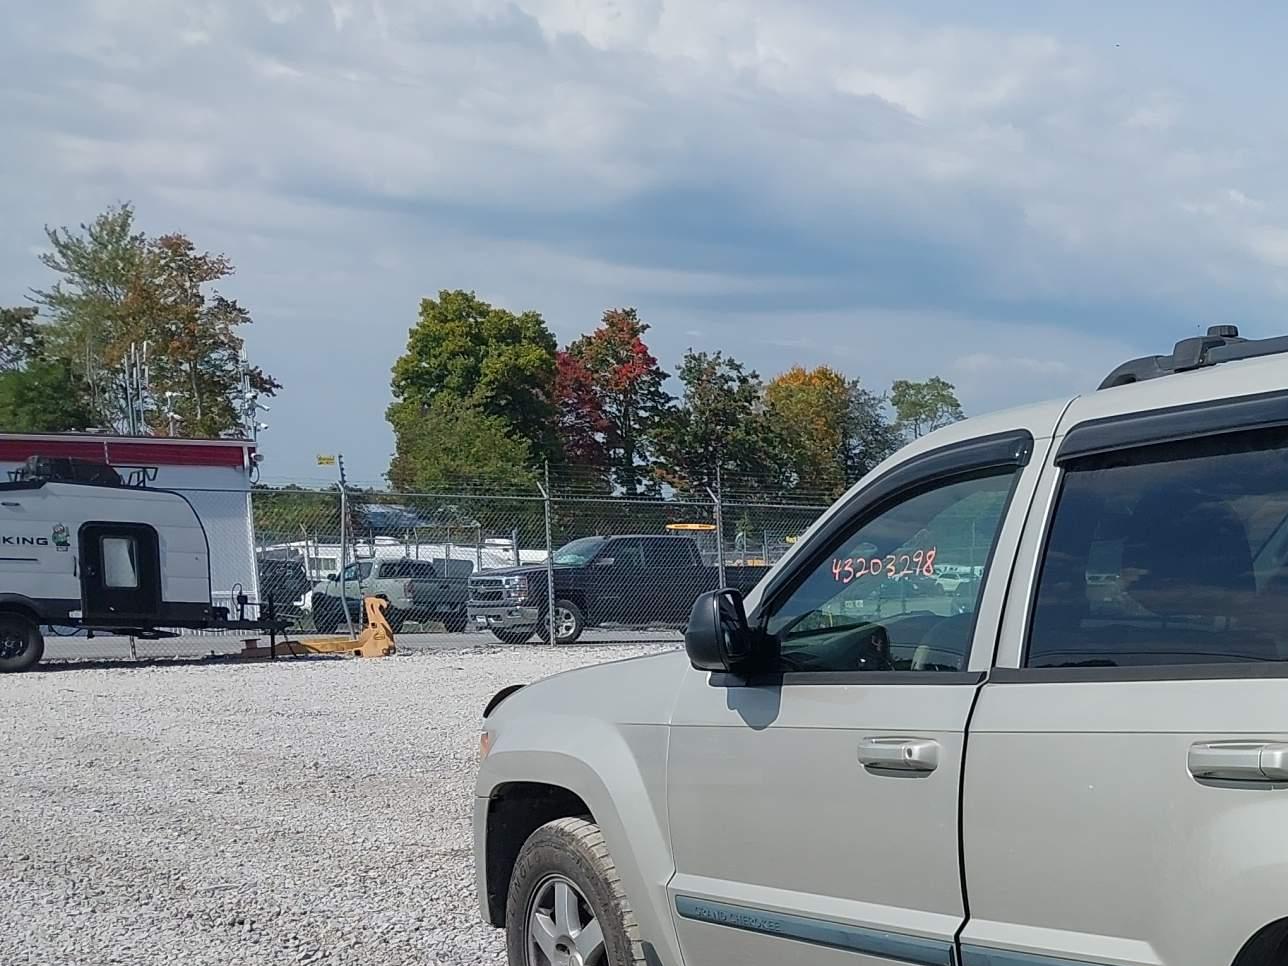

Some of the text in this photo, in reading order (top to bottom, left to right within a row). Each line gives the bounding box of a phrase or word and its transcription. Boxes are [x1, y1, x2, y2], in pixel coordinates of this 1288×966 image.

[2, 535, 49, 546] KING
[831, 546, 937, 584] 43203298
[695, 906, 783, 932] GRAND CHEROKEE
